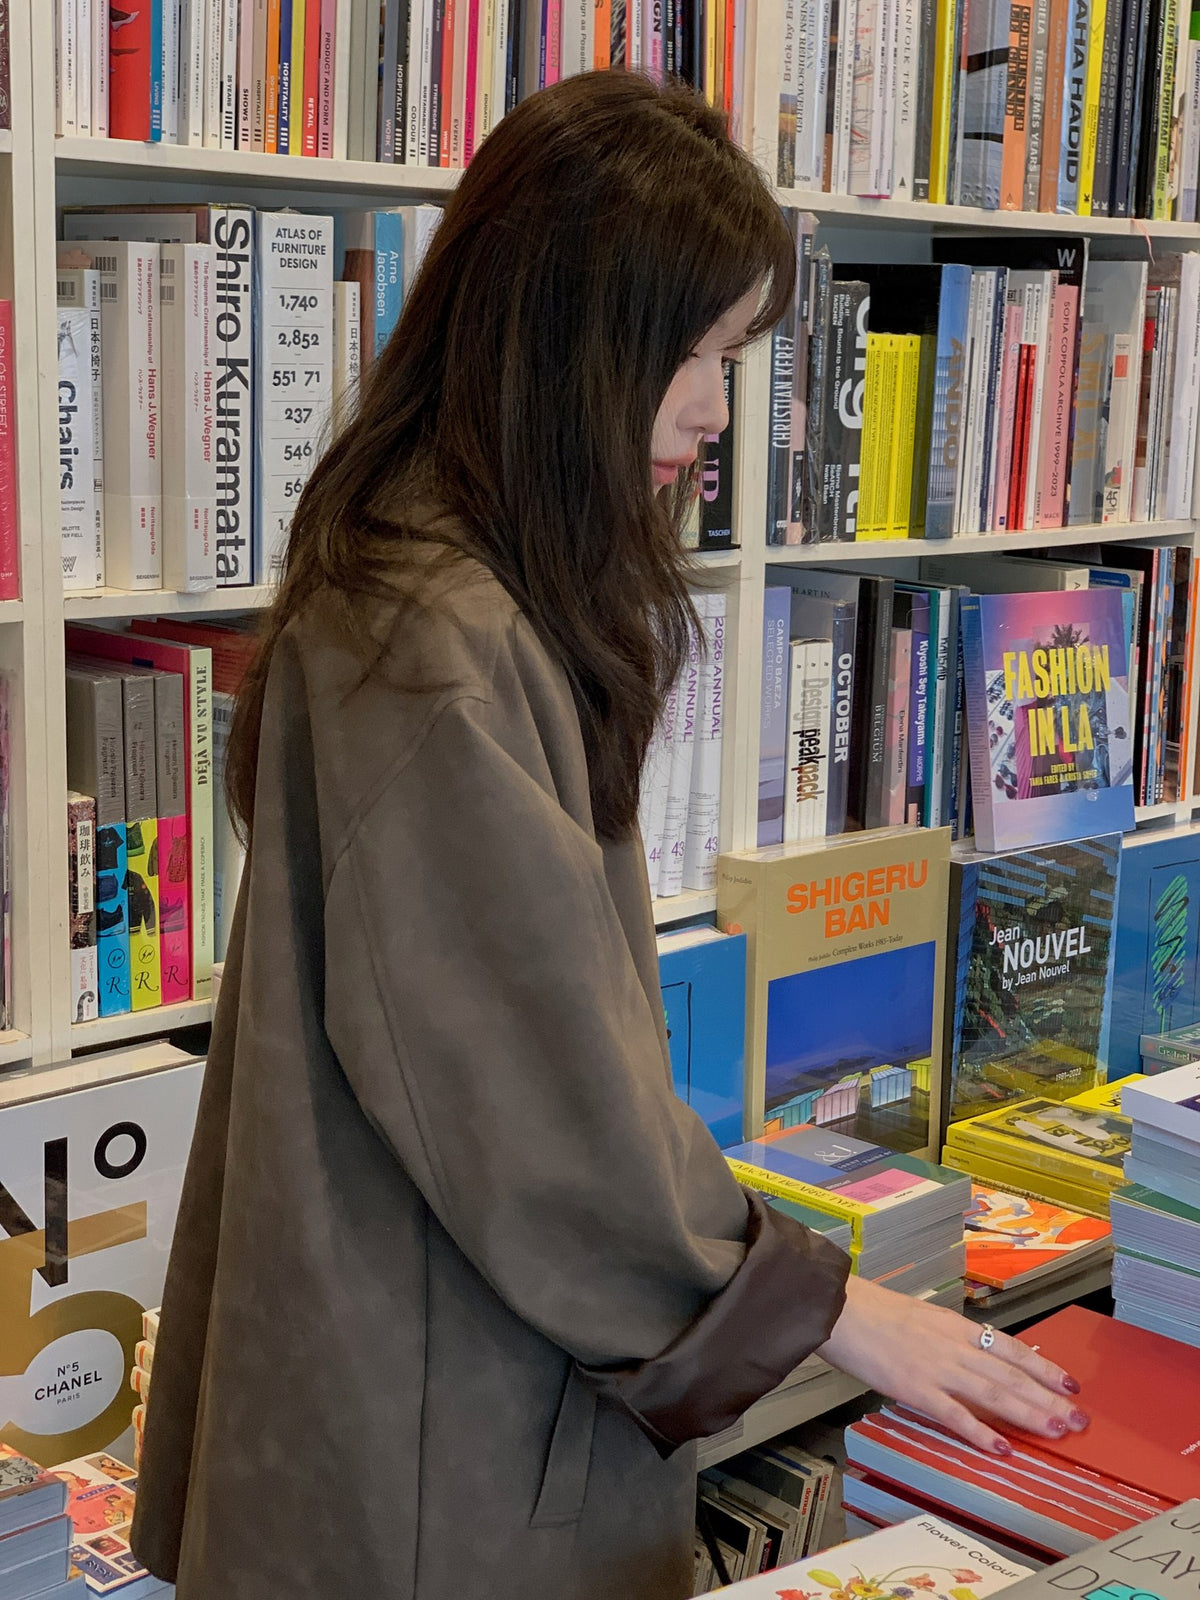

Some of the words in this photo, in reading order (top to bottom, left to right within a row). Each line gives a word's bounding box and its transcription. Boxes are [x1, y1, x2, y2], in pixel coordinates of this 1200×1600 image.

[580, 19, 586, 30] as
[784, 24, 796, 41] by
[822, 15, 830, 39] Good
[1010, 4, 1021, 33] LE
[1167, 23, 1176, 40] OF
[806, 6, 816, 71] SHULMAN
[820, 40, 829, 69] Design
[1165, 41, 1175, 63] THE
[783, 56, 793, 83] Brick
[1013, 6, 1031, 131] CORBUSIER
[1034, 49, 1046, 73] THE
[282, 62, 290, 122] HOSPITALITY
[396, 64, 404, 122] HOSPITALITY
[796, 37, 807, 134] REDISCOVERED
[818, 71, 827, 96] Today
[901, 71, 911, 125] TRAVEL
[1005, 47, 1019, 117] GRAND
[1065, 77, 1084, 184] HADID
[1159, 88, 1172, 148] PORTRAIT
[1028, 132, 1040, 172] YEARS
[271, 242, 326, 256] FURNITURE
[275, 227, 306, 240] ATLAS
[308, 229, 323, 240] OF
[279, 257, 318, 270] DESIGN
[389, 250, 399, 285] Arne
[1057, 249, 1076, 268] W
[145, 273, 154, 304] Supreme
[201, 275, 210, 306] Supreme
[215, 216, 251, 343] Shiro
[376, 249, 388, 317] Jacobsen
[279, 294, 319, 312] 1,740
[831, 294, 839, 326] TASCHEN
[837, 294, 846, 326] Building
[843, 293, 853, 308] dig
[844, 308, 852, 317] it!
[145, 305, 155, 356] Craftsmanship
[202, 307, 211, 358] Craftsmanship
[1062, 301, 1071, 334] SOFIA
[90, 317, 101, 382] 日本の椅子
[277, 329, 320, 350] 2,852
[147, 357, 154, 365] of
[203, 359, 210, 368] of
[835, 355, 842, 364] to
[1059, 336, 1069, 389] COPPOLA
[148, 368, 157, 399] Hans
[203, 371, 213, 402] Hans
[272, 370, 297, 387] 551
[304, 370, 321, 387] 71
[148, 402, 157, 412] J.
[203, 404, 213, 414] J.
[832, 380, 840, 410] Ground
[284, 407, 313, 424] 237
[772, 381, 793, 449] CHRISTIAN
[1055, 390, 1066, 438] ARCHIVE
[59, 380, 79, 490] Chairs
[146, 413, 157, 460] Wegner
[201, 416, 213, 463] Wegner
[283, 441, 313, 461] 546
[215, 357, 250, 579] Kuramata
[828, 463, 837, 498] SeARCH
[834, 463, 843, 491] Bjarne
[1106, 490, 1119, 508] 45
[149, 506, 157, 540] Noritsugu
[832, 493, 841, 540] Mastenbroek
[708, 529, 731, 537] TASCHEN
[713, 616, 724, 661] 2026
[765, 619, 776, 681] SELECTED
[775, 618, 786, 665] CAMPO
[914, 639, 929, 676] Kiyoshi
[1003, 645, 1112, 701] FASHION
[196, 666, 208, 718] STYLE
[710, 665, 723, 740] ANNUAL
[774, 666, 784, 710] BAEZA
[914, 678, 928, 696] Sey
[683, 667, 697, 743] ANNUAL
[763, 683, 773, 729] WORKS
[834, 652, 853, 764] OCTOBER
[897, 709, 906, 732] Elena
[197, 723, 208, 744] VU
[871, 704, 882, 764] BELGIUM
[913, 698, 927, 747] Takeyama
[1027, 707, 1056, 757] IN
[1062, 703, 1094, 753] LA
[109, 737, 117, 764] Hiroshi
[131, 741, 140, 777] Fragment
[139, 740, 147, 765] Hiroshi
[164, 740, 172, 776] Fragment
[108, 765, 117, 799] Fujiwara
[170, 767, 179, 799] Fujiwara
[195, 748, 211, 786] DÉJÀ
[1051, 764, 1068, 774] EDITED
[1068, 763, 1075, 772] BY
[138, 768, 147, 801] Fujiwara
[79, 825, 91, 878] 珈琲飲み
[671, 840, 685, 857] 43
[704, 836, 719, 851] 43
[786, 859, 929, 915] SHIGERU
[824, 898, 891, 939] BAN
[832, 943, 858, 958] Complete
[857, 940, 875, 952] Works
[988, 926, 1020, 946] Jean
[1003, 926, 1092, 974] NOUVEL
[106, 975, 130, 996] R
[134, 970, 159, 991] R
[163, 964, 188, 985] R
[1001, 976, 1013, 991] by
[1014, 969, 1037, 987] Jean
[1039, 960, 1070, 979] Nouvel
[34, 1370, 103, 1401] CHANEL
[56, 1392, 81, 1405] PARIS
[801, 1487, 812, 1516] domus
[820, 1473, 830, 1501] domus
[917, 1521, 969, 1551] Flower
[967, 1549, 1021, 1579] Colour
